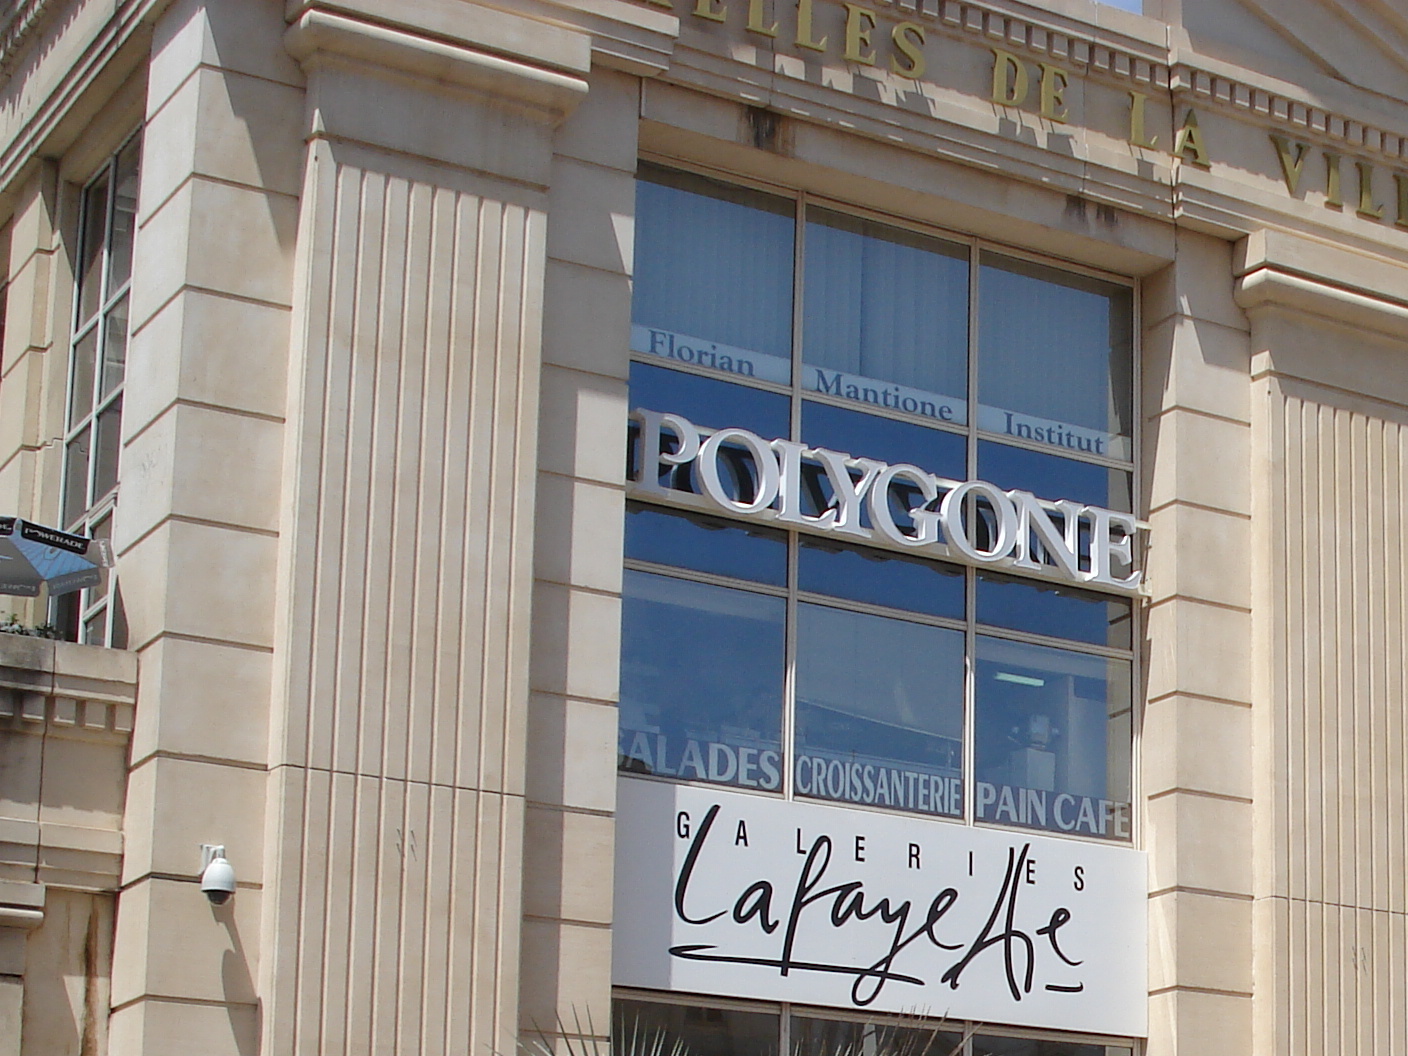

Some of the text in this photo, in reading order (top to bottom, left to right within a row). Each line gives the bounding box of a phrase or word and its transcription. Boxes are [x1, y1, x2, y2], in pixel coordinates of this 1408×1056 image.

[992, 47, 1070, 124] DE
[1127, 90, 1212, 170] LA
[648, 328, 1105, 455] Florian Mantione Institut
[24, 527, 85, 550] POWERADE
[629, 406, 1143, 589] POLYGONE
[795, 755, 961, 816] CROISSANTERIE
[975, 781, 1131, 838] PAIN CAFE
[676, 811, 1086, 892] GALERIES
[669, 804, 1084, 1007] Lafayette
